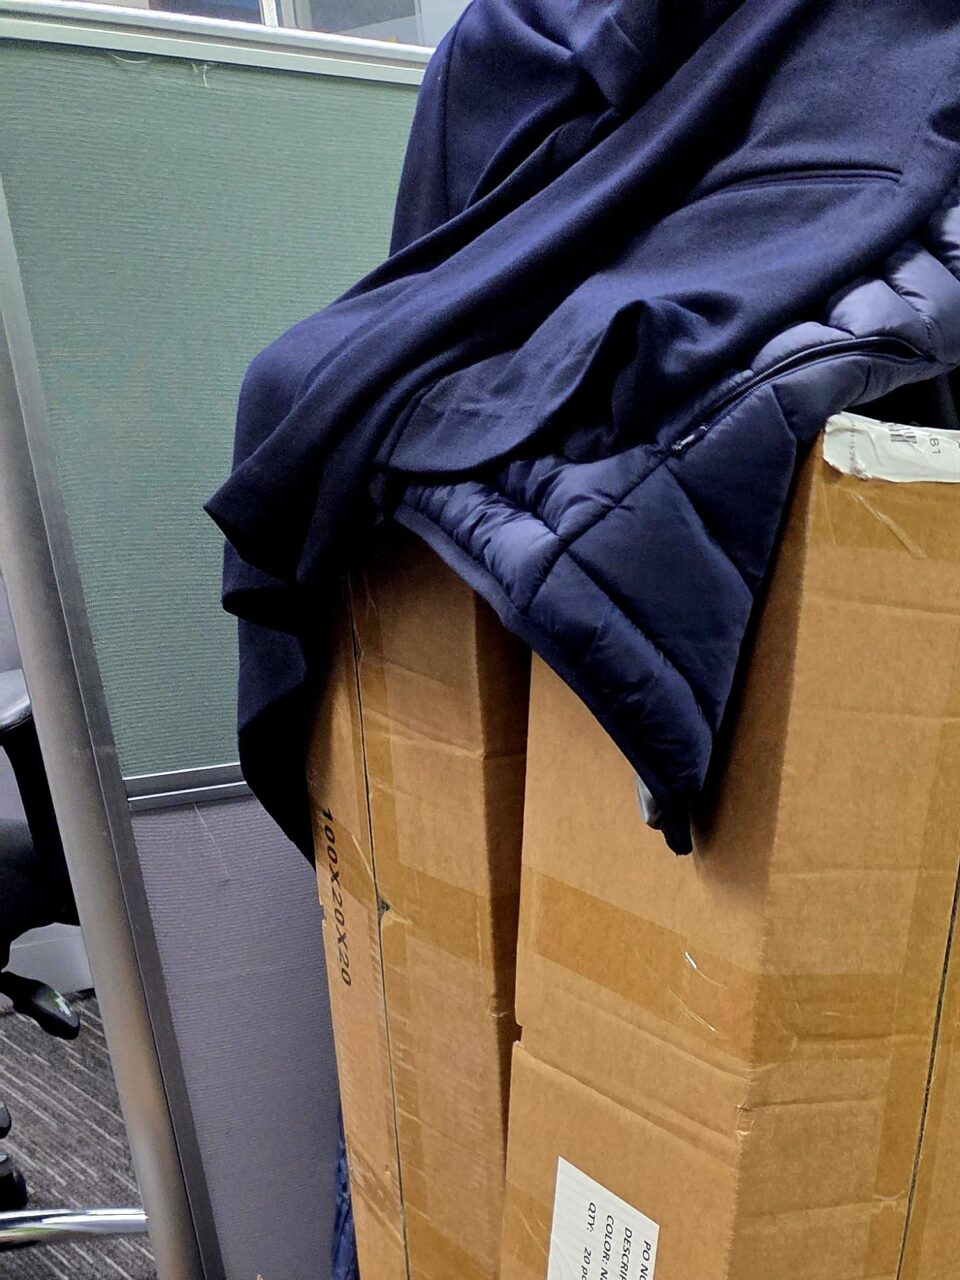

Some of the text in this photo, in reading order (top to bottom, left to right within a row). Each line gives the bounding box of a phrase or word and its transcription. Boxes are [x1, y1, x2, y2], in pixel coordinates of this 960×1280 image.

[585, 1201, 597, 1233] QTY:
[600, 1214, 615, 1267] COLOR:
[642, 1240, 652, 1261] PO
[583, 1246, 592, 1265] 20
